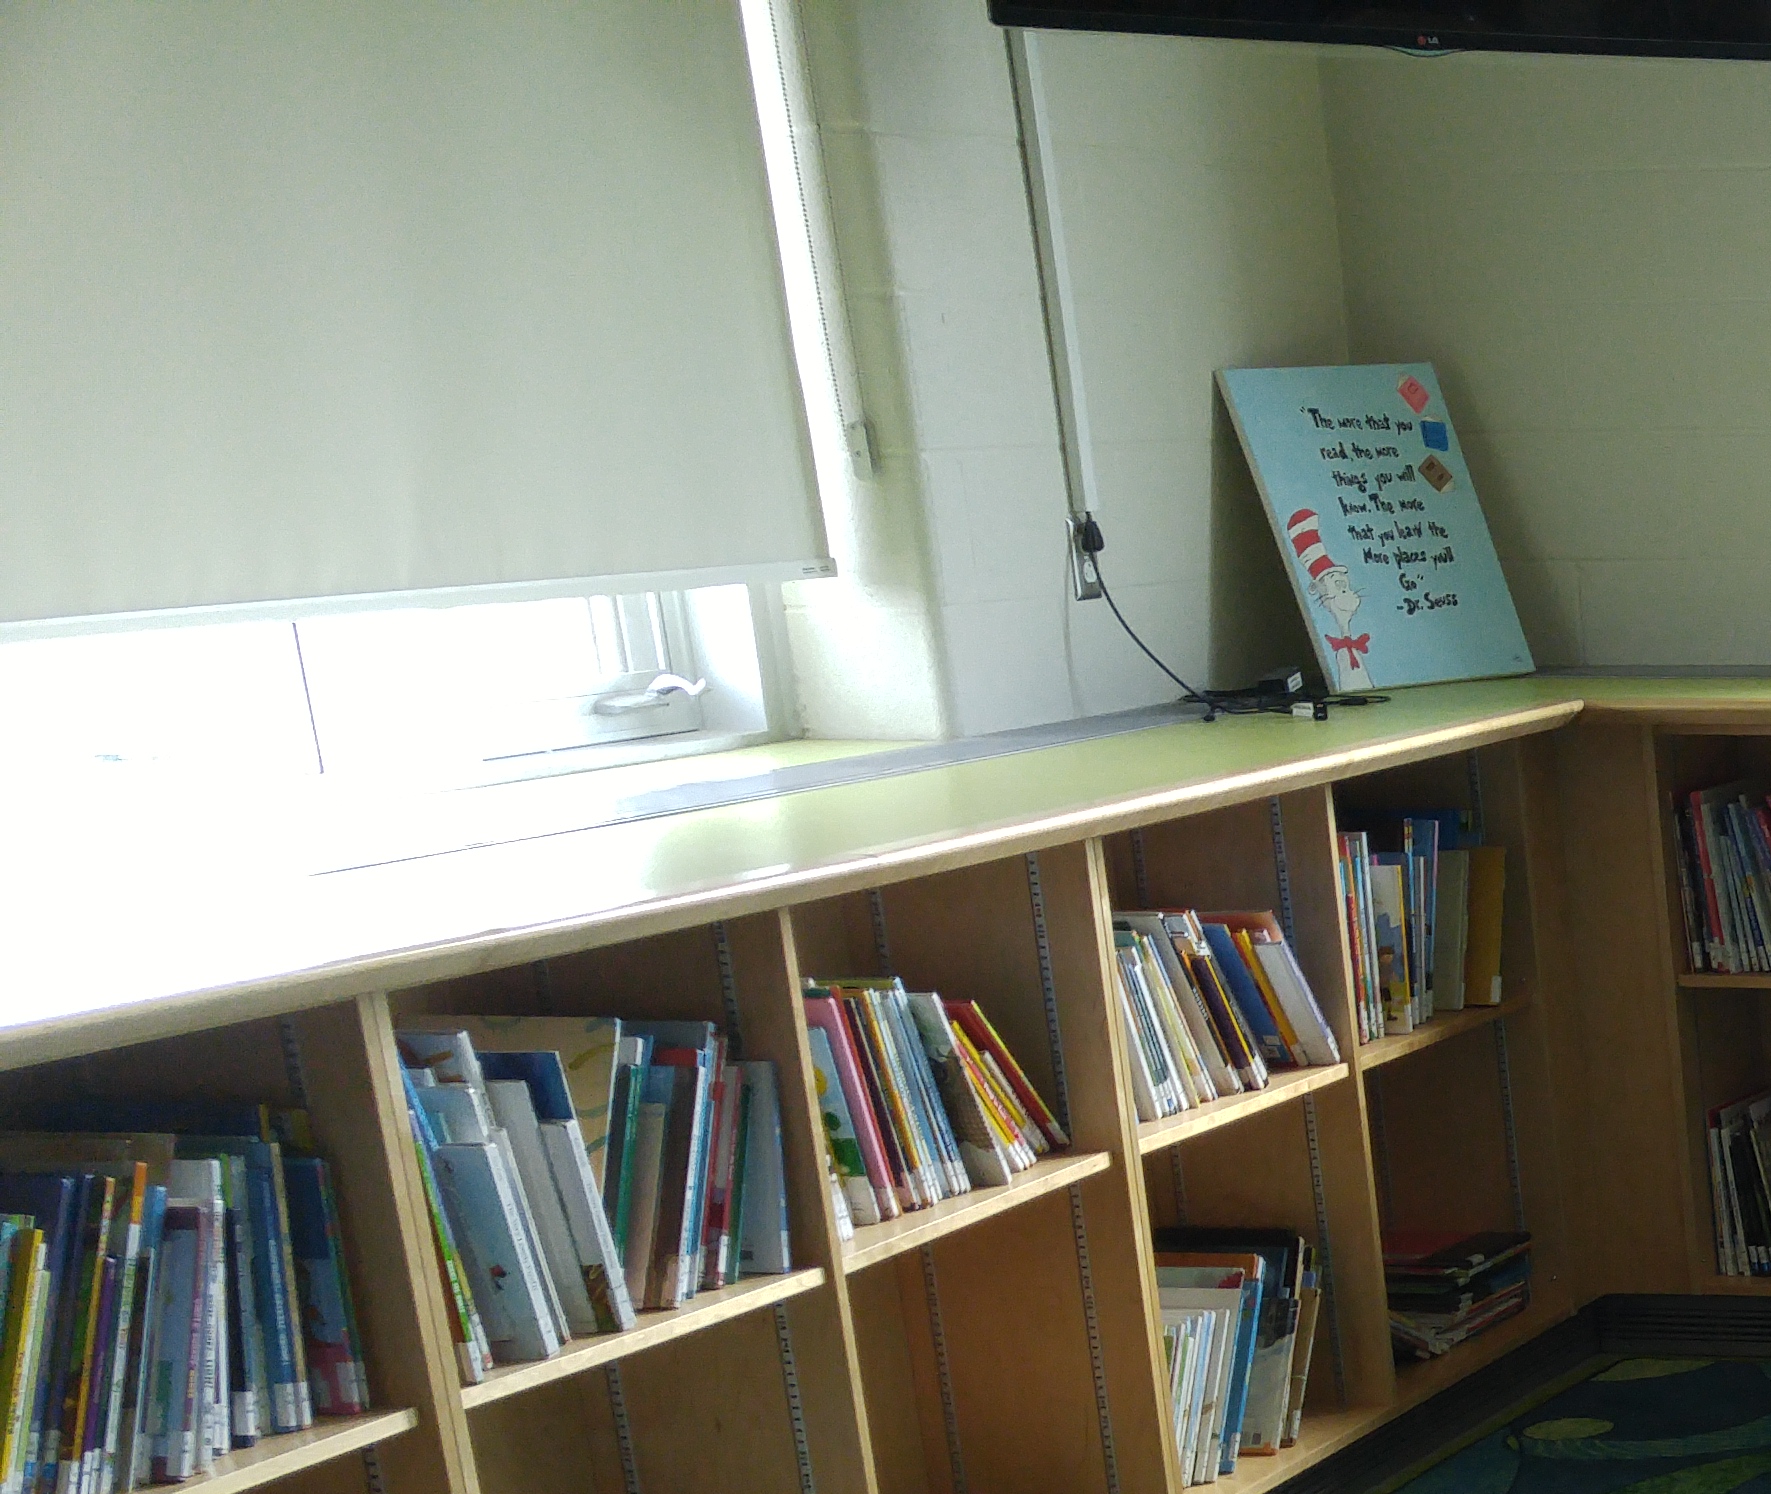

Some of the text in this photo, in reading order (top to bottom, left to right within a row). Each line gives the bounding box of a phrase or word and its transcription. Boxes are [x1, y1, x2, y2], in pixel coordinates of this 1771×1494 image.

[1337, 418, 1363, 430] more
[1365, 413, 1391, 430] that
[1394, 421, 1413, 435] you
[1351, 442, 1373, 460] the
[1375, 446, 1399, 458] more
[1332, 464, 1416, 493] things you will
[1338, 493, 1425, 517] know. The more
[1347, 520, 1448, 547] that you learn the
[1393, 546, 1427, 570] places
[1424, 592, 1458, 610] Seuss
